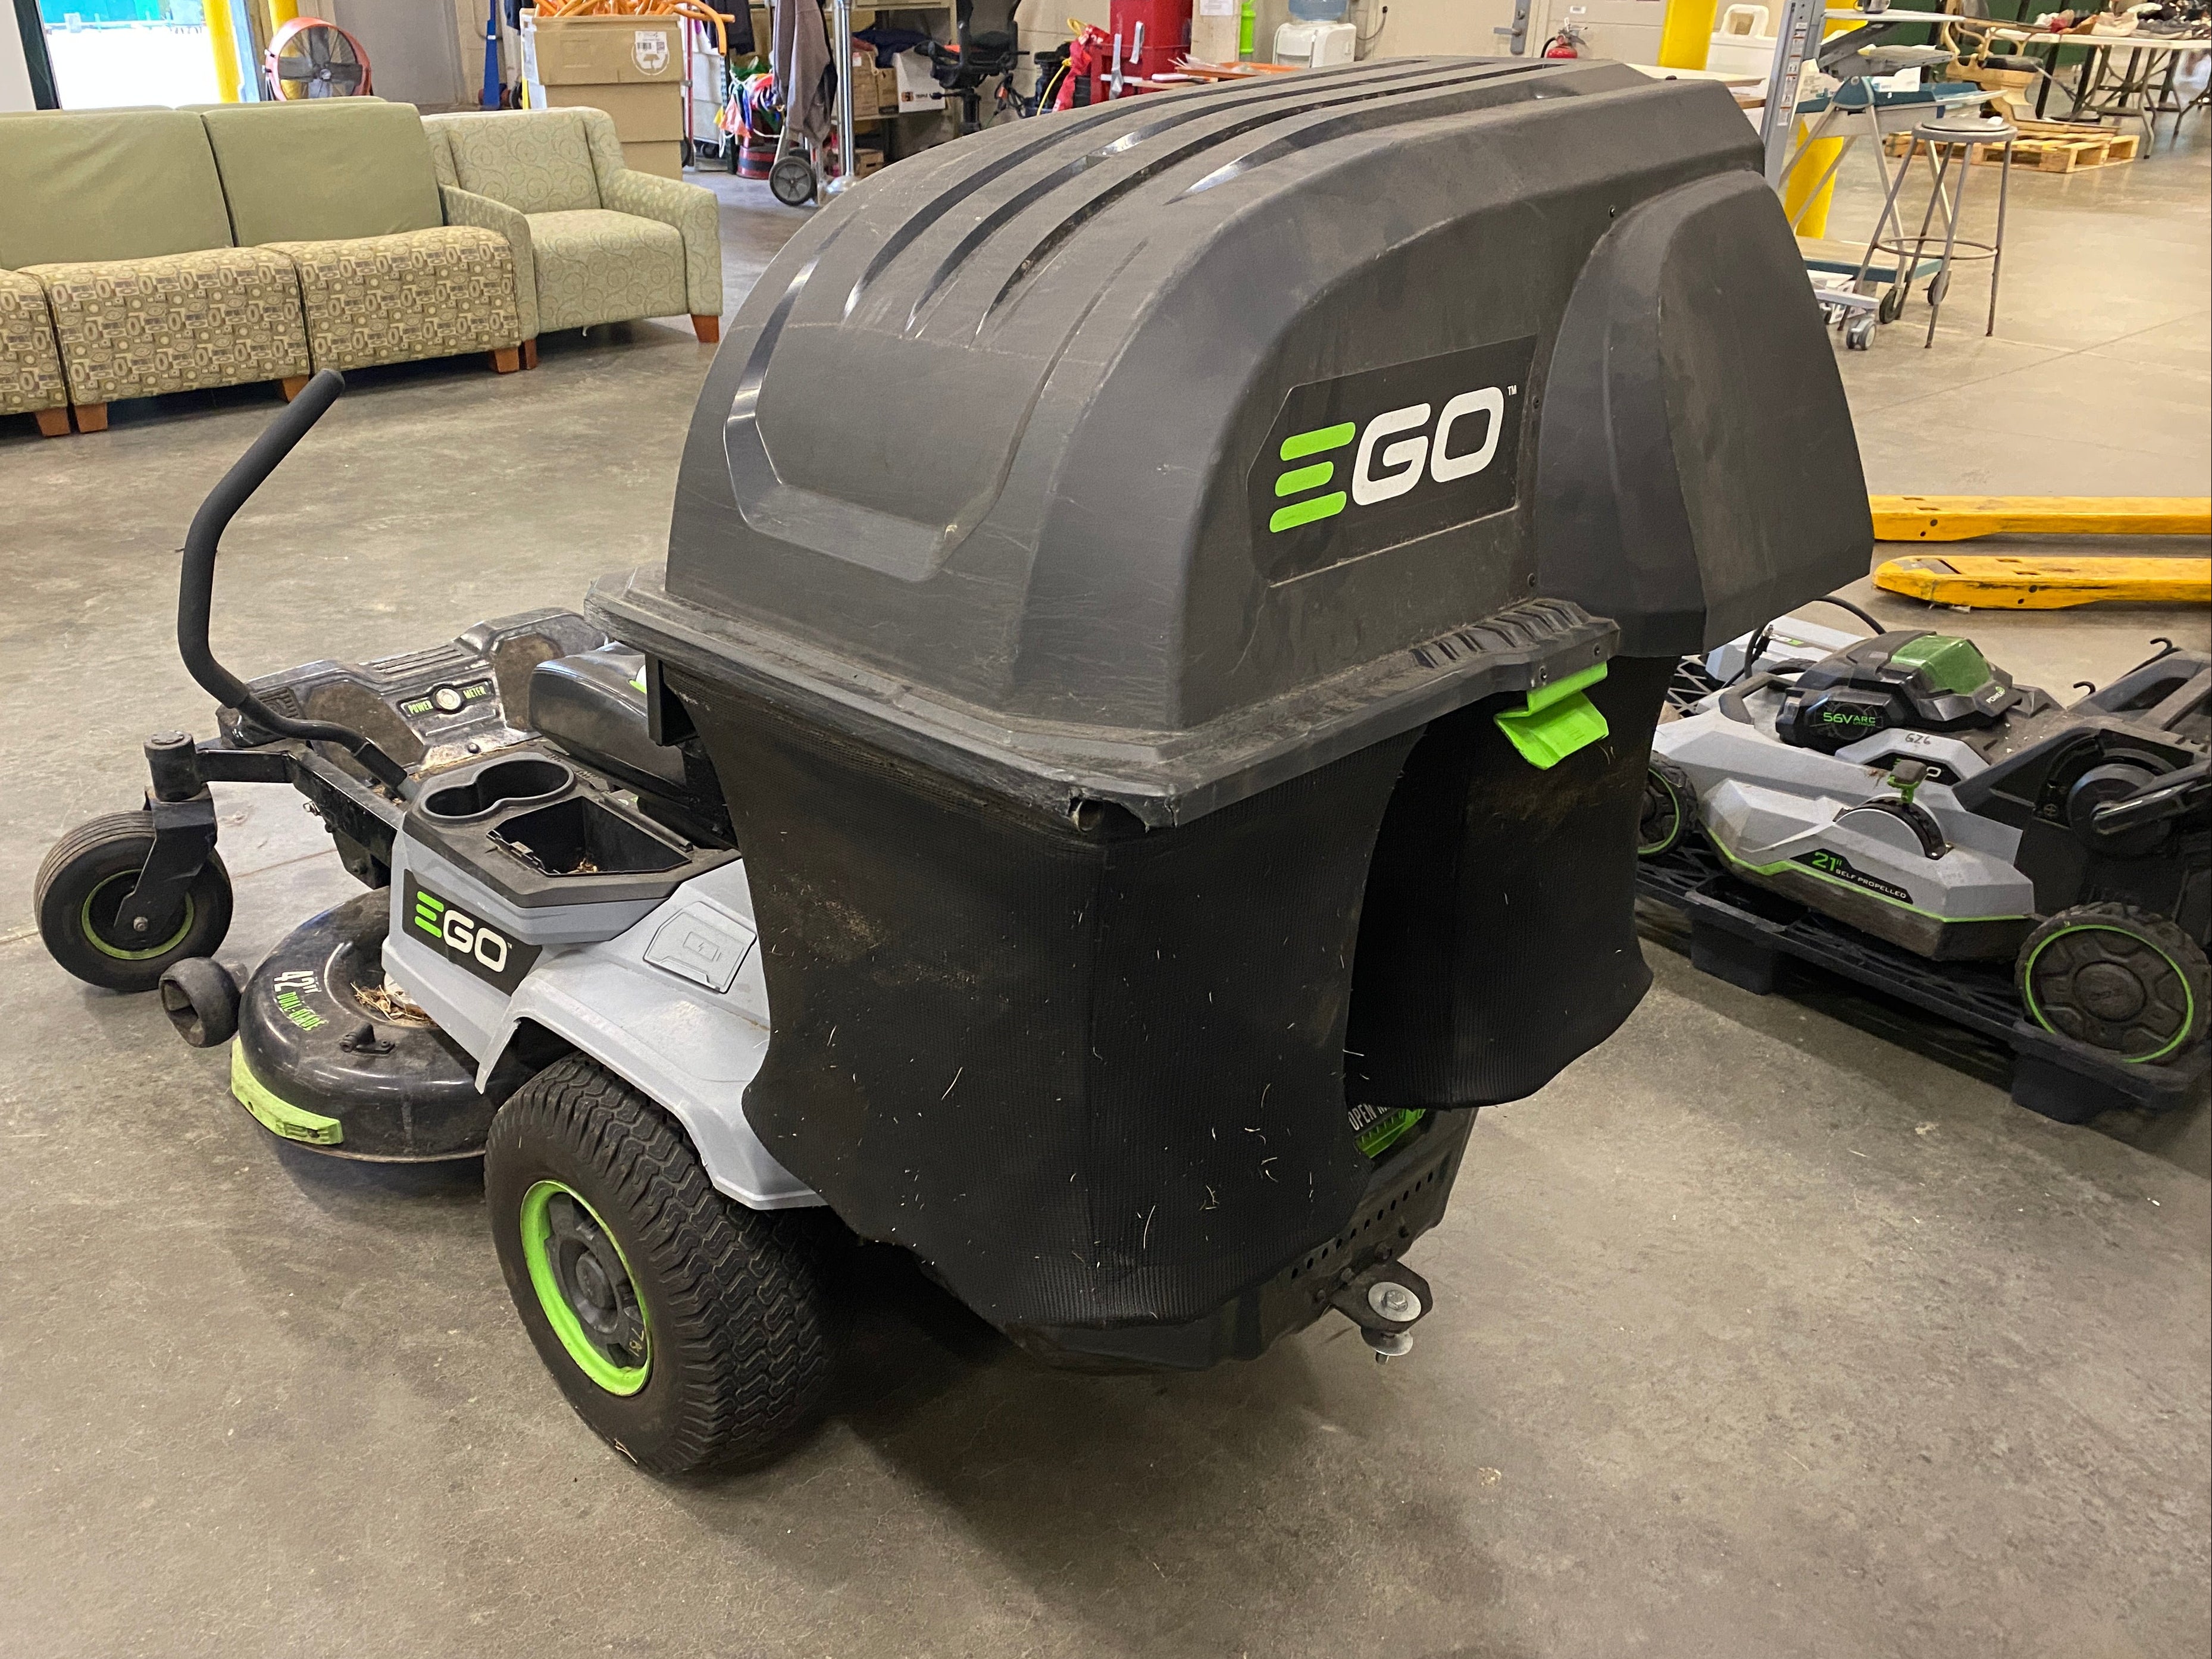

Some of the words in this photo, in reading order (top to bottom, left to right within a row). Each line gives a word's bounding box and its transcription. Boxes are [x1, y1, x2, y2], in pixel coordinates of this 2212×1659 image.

[1269, 386, 1504, 533] EGO
[408, 700, 433, 714] POWER
[463, 686, 486, 699] METER
[1835, 868, 1856, 879] SELF
[1857, 877, 1907, 896] PROPELLED
[414, 891, 507, 972] EGO
[274, 971, 318, 994] 42"
[1347, 1103, 1377, 1131] OPEN
